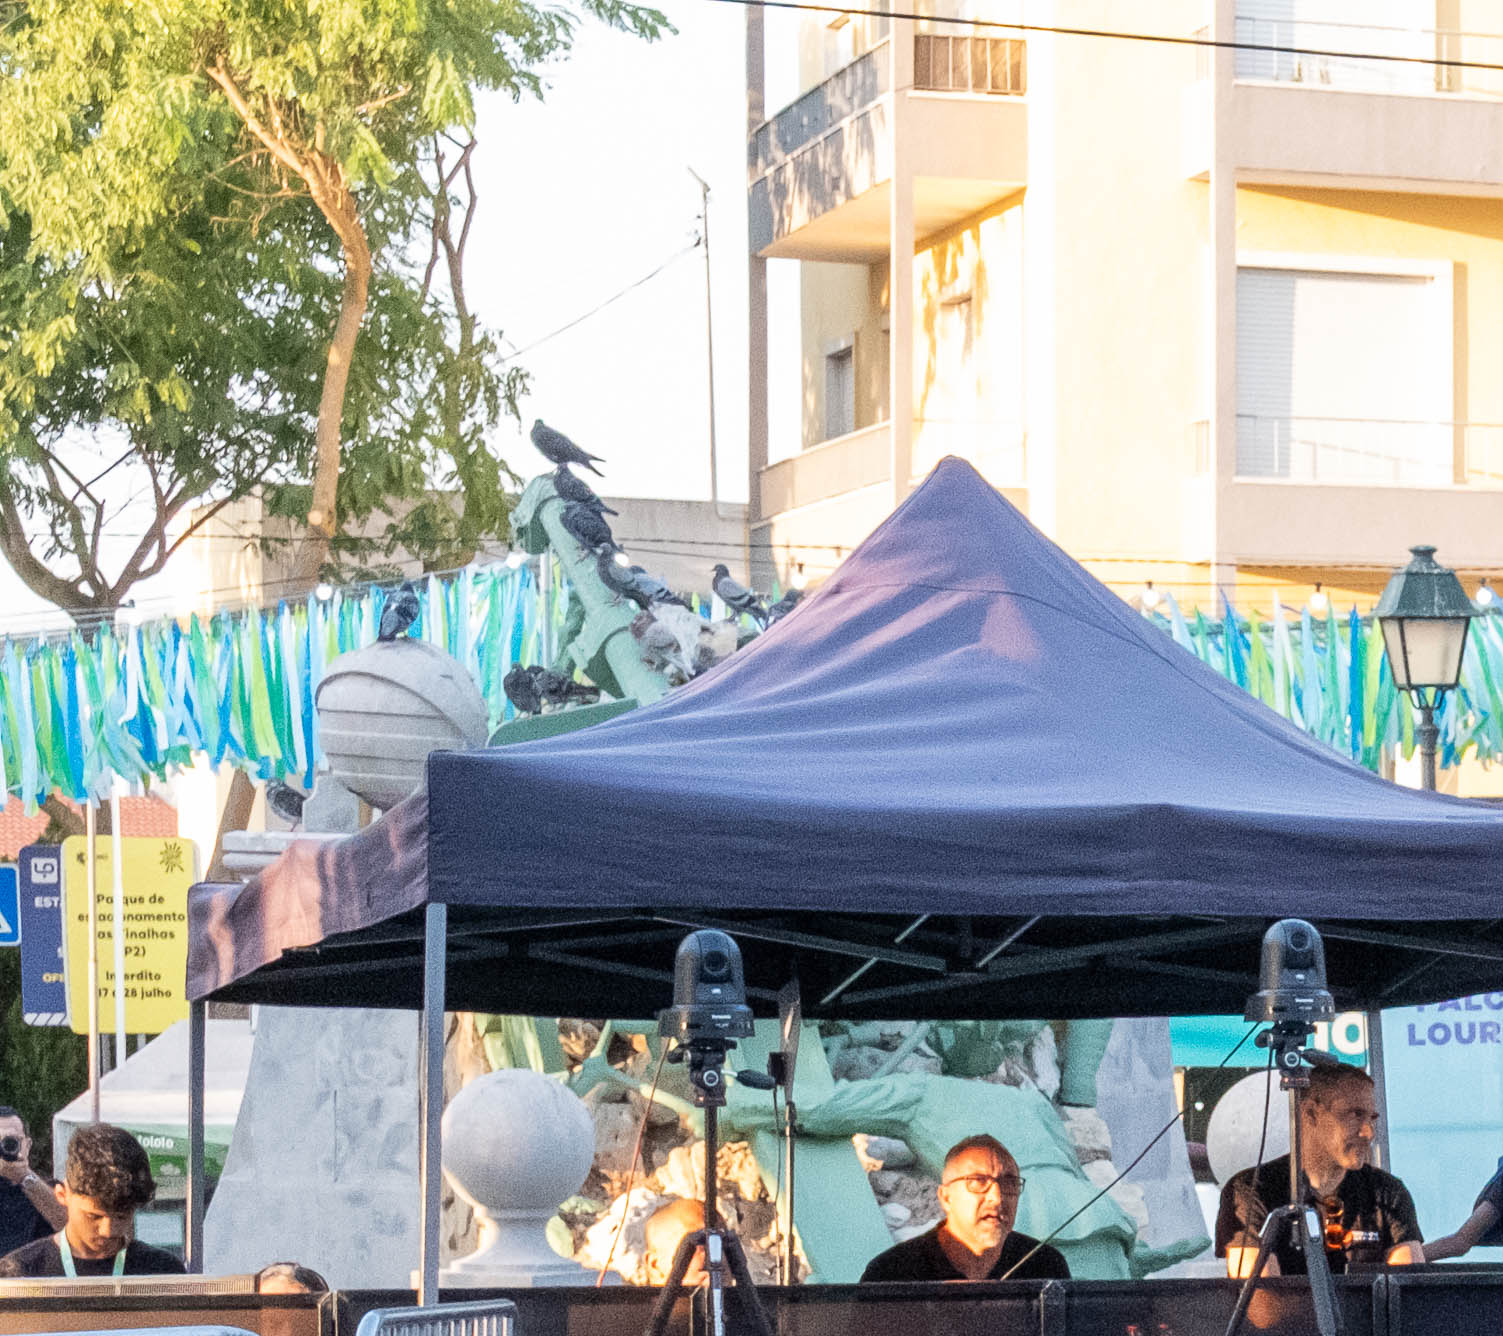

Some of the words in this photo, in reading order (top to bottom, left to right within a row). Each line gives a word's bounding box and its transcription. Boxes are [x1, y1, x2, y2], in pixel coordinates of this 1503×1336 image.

[96, 894, 145, 906] Paque
[148, 893, 165, 904] de
[123, 928, 176, 940] inalhas
[124, 946, 147, 958] P2)
[106, 970, 162, 981] Inerdito
[140, 987, 173, 1000] julho
